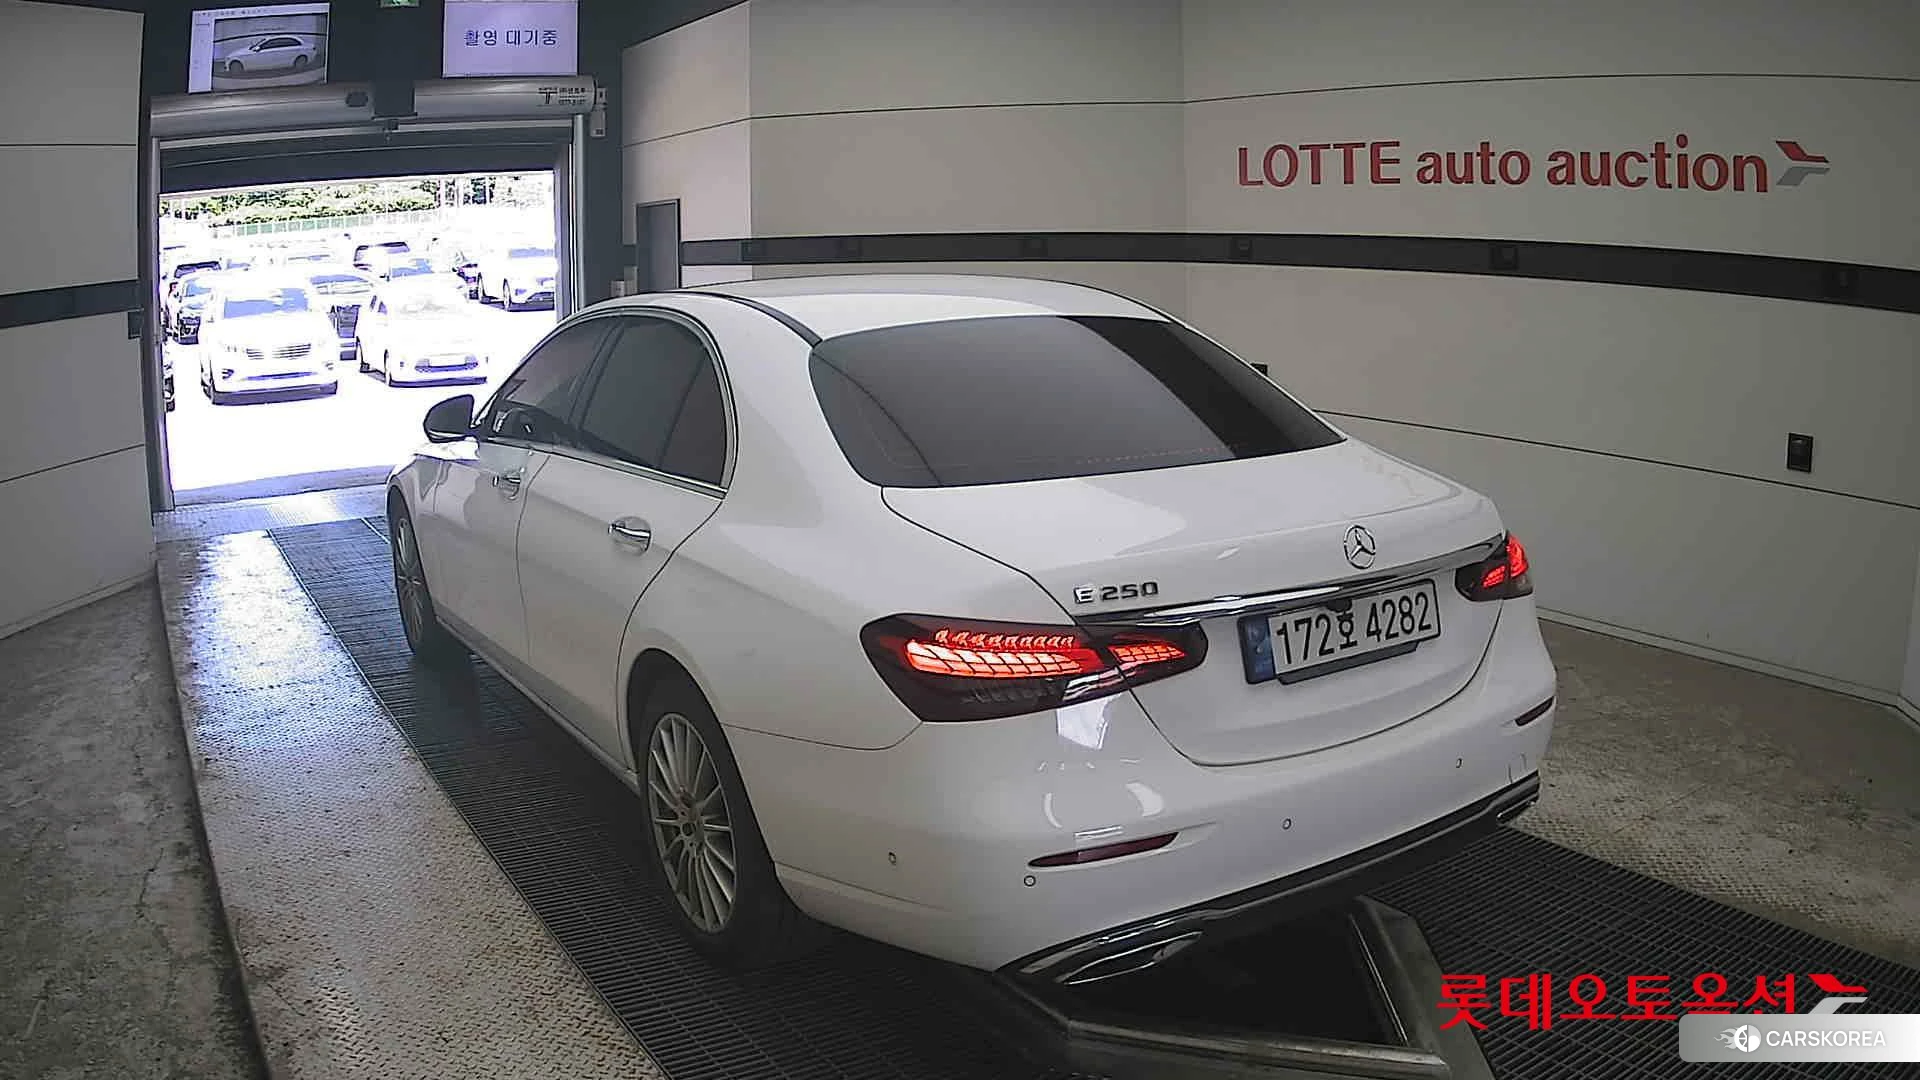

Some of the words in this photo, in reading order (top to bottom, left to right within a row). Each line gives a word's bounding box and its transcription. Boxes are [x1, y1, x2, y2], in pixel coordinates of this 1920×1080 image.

[463, 29, 498, 47] 촬영
[505, 29, 557, 46] 대기중
[1238, 140, 1400, 187] LOTTE
[1416, 141, 1531, 185] auto
[1546, 134, 1768, 193] auction
[1073, 586, 1094, 604] E
[1100, 581, 1159, 602] 250
[1366, 591, 1432, 643] 4282
